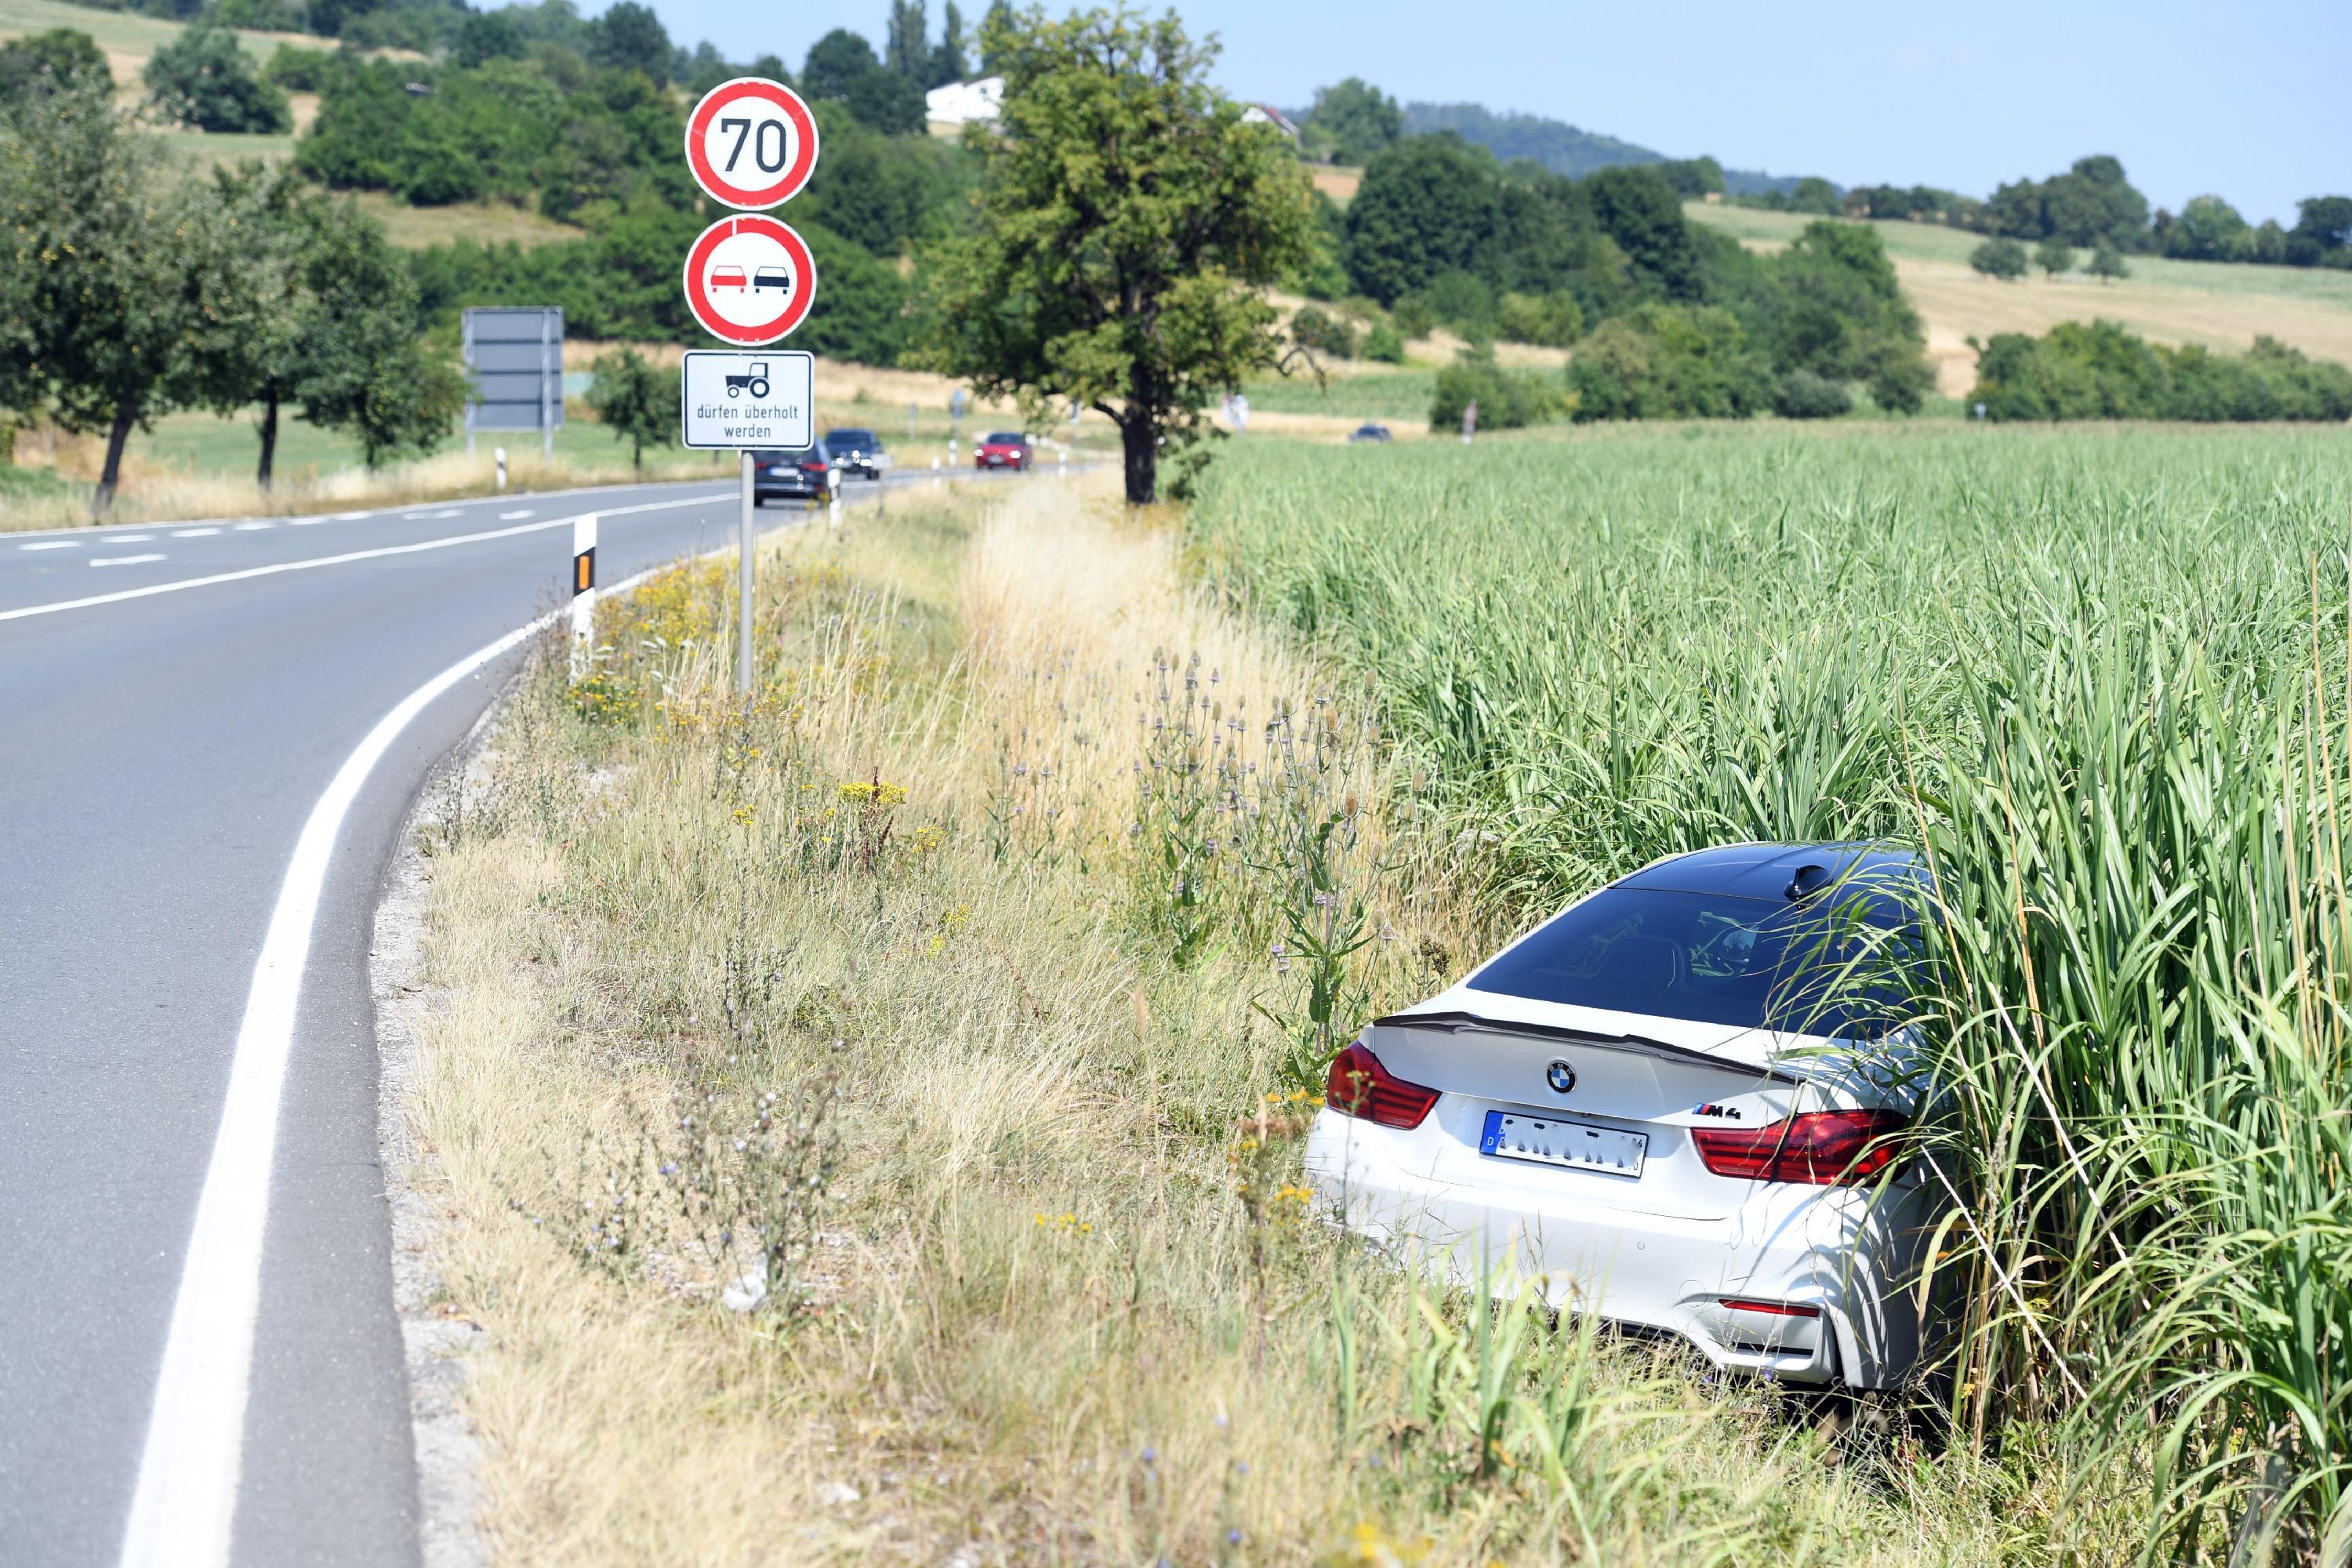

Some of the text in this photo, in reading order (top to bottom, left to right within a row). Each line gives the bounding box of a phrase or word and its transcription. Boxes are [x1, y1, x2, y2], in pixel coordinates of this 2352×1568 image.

[721, 118, 786, 173] 70
[697, 405, 798, 419] dürfen überholt
[724, 424, 771, 437] werden
[1549, 1063, 1573, 1075] BMW
[1487, 1136, 1494, 1146] D
